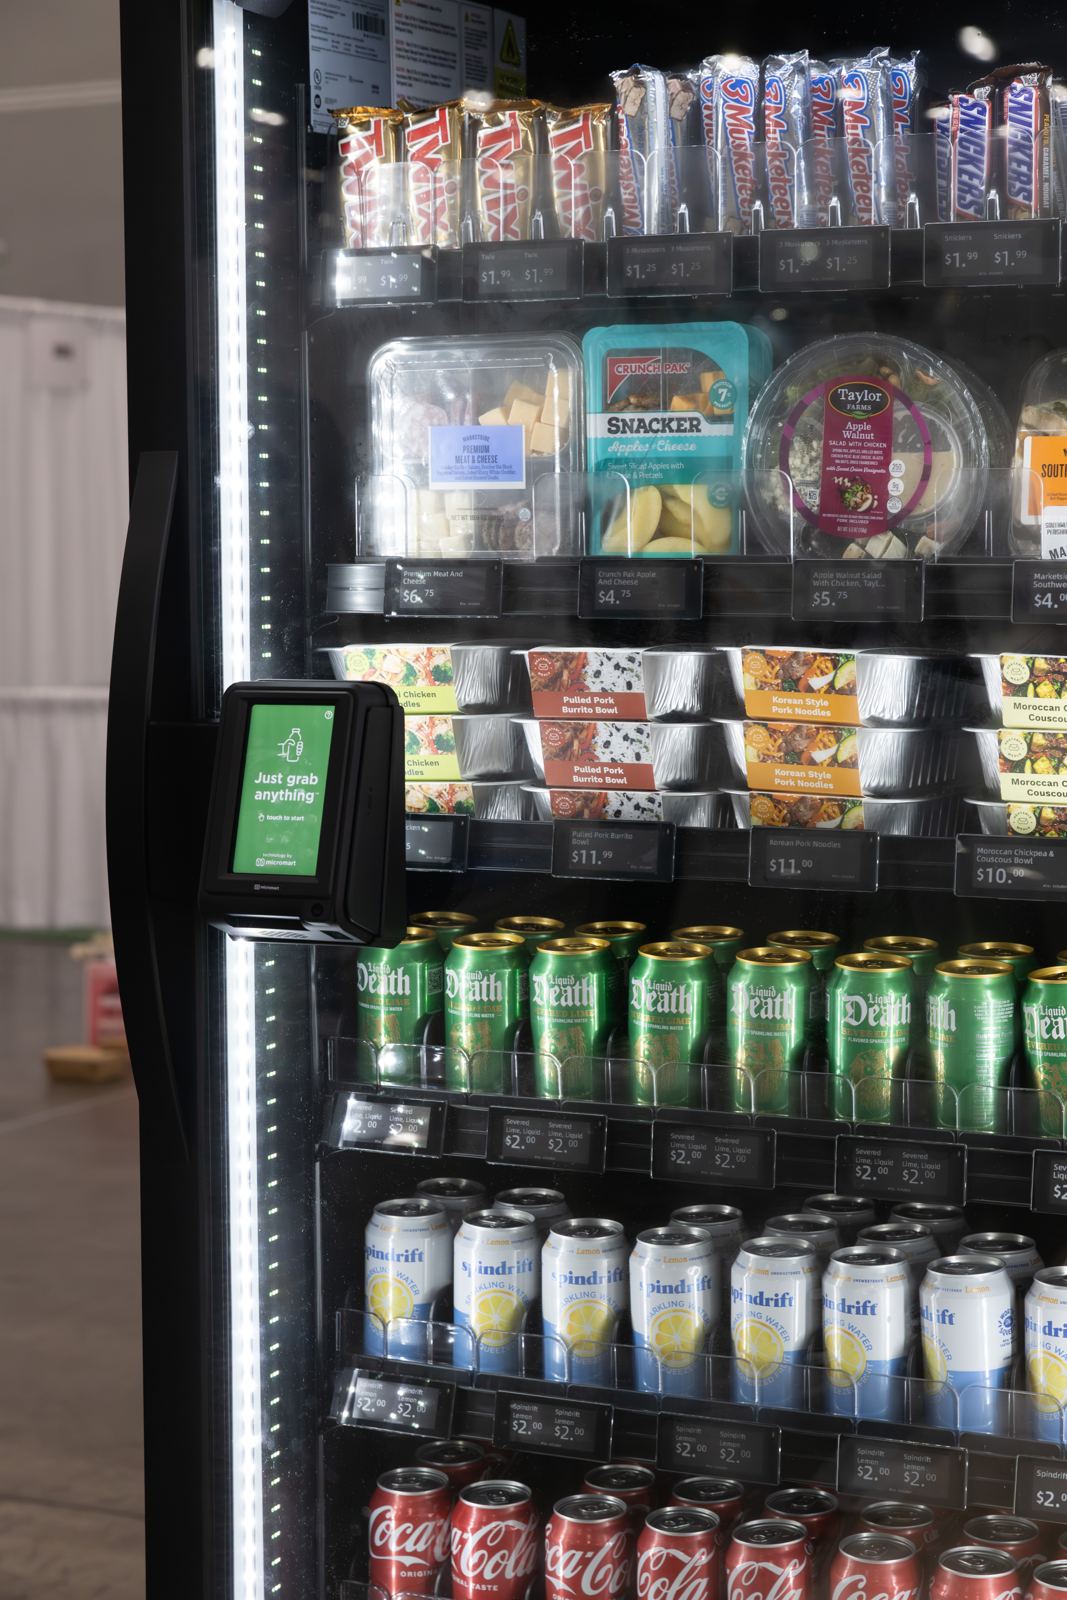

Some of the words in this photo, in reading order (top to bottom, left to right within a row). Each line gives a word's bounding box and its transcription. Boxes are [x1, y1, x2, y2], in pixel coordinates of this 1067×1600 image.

[720, 77, 750, 104] 3
[1008, 81, 1035, 206] SNICKERS
[844, 100, 876, 226] Musketeers
[957, 95, 988, 218] SNICKERS
[765, 104, 796, 229] Musketeers
[993, 232, 1022, 240] Snickers
[944, 251, 979, 268] $1.99
[994, 249, 1028, 267] $1.99
[481, 268, 511, 285] $1.99
[614, 363, 661, 375] CRUNCH
[664, 362, 689, 374] PAK
[718, 388, 730, 402] 7
[838, 387, 882, 404] Taylor
[607, 416, 702, 435] SNACKER
[846, 421, 872, 431] Apple
[842, 430, 875, 440] Walnut
[462, 445, 490, 454] PREMIUM
[455, 455, 470, 464] MEAT
[477, 454, 498, 464] CHEESE
[598, 589, 632, 604] $4.75
[813, 591, 848, 606] $5.75
[563, 696, 591, 704] Pulled
[772, 696, 803, 705] Korean
[806, 698, 829, 707] Style
[1013, 702, 1060, 712] Moroccan
[562, 706, 593, 714] Burrito
[772, 706, 792, 714] Pork
[795, 707, 831, 717] Noodles
[574, 766, 601, 774] Pulled
[604, 767, 624, 775] Pork
[774, 769, 806, 778] Korean
[808, 770, 832, 780] Style
[254, 772, 283, 785] Just
[287, 772, 319, 786] grab
[573, 776, 603, 784] Burrito
[605, 776, 627, 785] Bowl
[775, 778, 795, 787] Pork
[797, 780, 834, 789] Noodles
[1011, 777, 1059, 787] Moroccan
[254, 788, 315, 804] anything
[266, 814, 282, 822] touch
[571, 850, 613, 865] $11.99
[1014, 848, 1047, 857] Chickpea
[265, 858, 296, 866] micromart
[769, 858, 813, 874] $11.00
[977, 868, 1025, 884] $10.00
[357, 963, 411, 996] Death
[550, 974, 575, 986] Liquid
[648, 980, 673, 992] Liquid
[533, 974, 596, 1007] Death
[631, 977, 694, 1014] Death
[750, 985, 777, 998] Liquid
[730, 983, 797, 1020] Death
[843, 991, 911, 1027] Death
[1040, 1005, 1067, 1017] Liquid
[506, 1118, 530, 1126] Severed
[505, 1134, 536, 1150] $2.00
[548, 1138, 578, 1153] $2.00
[670, 1149, 702, 1165] $2.00
[715, 1153, 747, 1169] $2.00
[902, 1152, 928, 1160] Severed
[855, 1165, 889, 1180] $2.00
[902, 1168, 936, 1185] $2.00
[396, 1271, 420, 1296] WATER
[766, 1314, 791, 1343] WATER
[847, 1323, 873, 1352] WATER
[356, 1398, 386, 1412] $2.00
[397, 1403, 427, 1418] $2.00
[554, 1408, 581, 1417] Spindrift
[512, 1412, 533, 1420] Lemon
[554, 1417, 575, 1425] Lemon
[512, 1420, 543, 1435] $2.00
[554, 1426, 585, 1441] $2.00
[675, 1442, 708, 1458] $2.00
[720, 1448, 751, 1464] $2.00
[857, 1447, 885, 1457] Spindrift
[857, 1457, 879, 1465] Lemon
[904, 1453, 932, 1463] Spindrift
[857, 1465, 890, 1481] $2.00
[904, 1463, 926, 1472] Lemon
[904, 1471, 937, 1487] $2.00
[471, 1583, 498, 1591] TASTE
